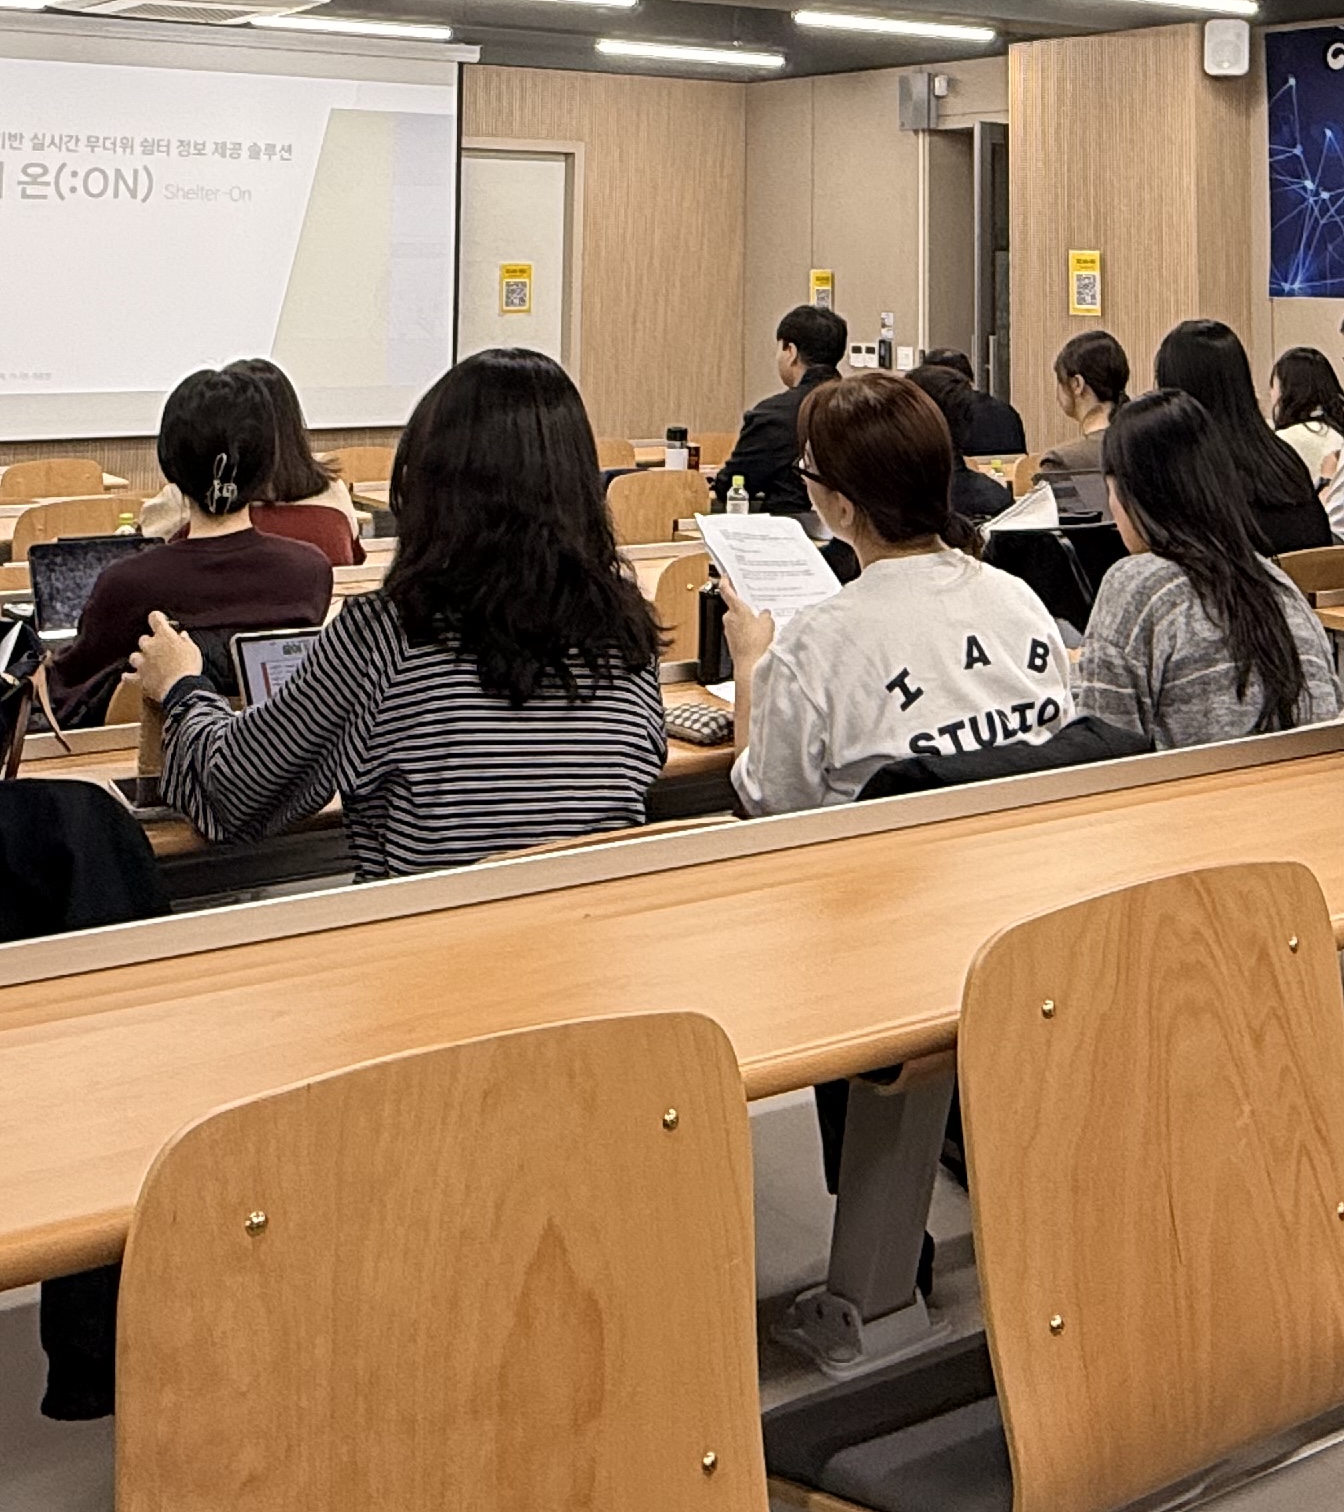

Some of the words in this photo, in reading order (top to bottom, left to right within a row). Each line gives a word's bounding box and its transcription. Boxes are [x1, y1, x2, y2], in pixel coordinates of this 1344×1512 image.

[30, 132, 81, 153] 실시간
[85, 134, 134, 156] 무더위
[140, 138, 171, 157] 쉼터
[176, 139, 208, 158] 정보
[212, 141, 242, 160] 제공
[247, 142, 293, 162] 솔루션
[16, 162, 154, 204] 온(:ON)
